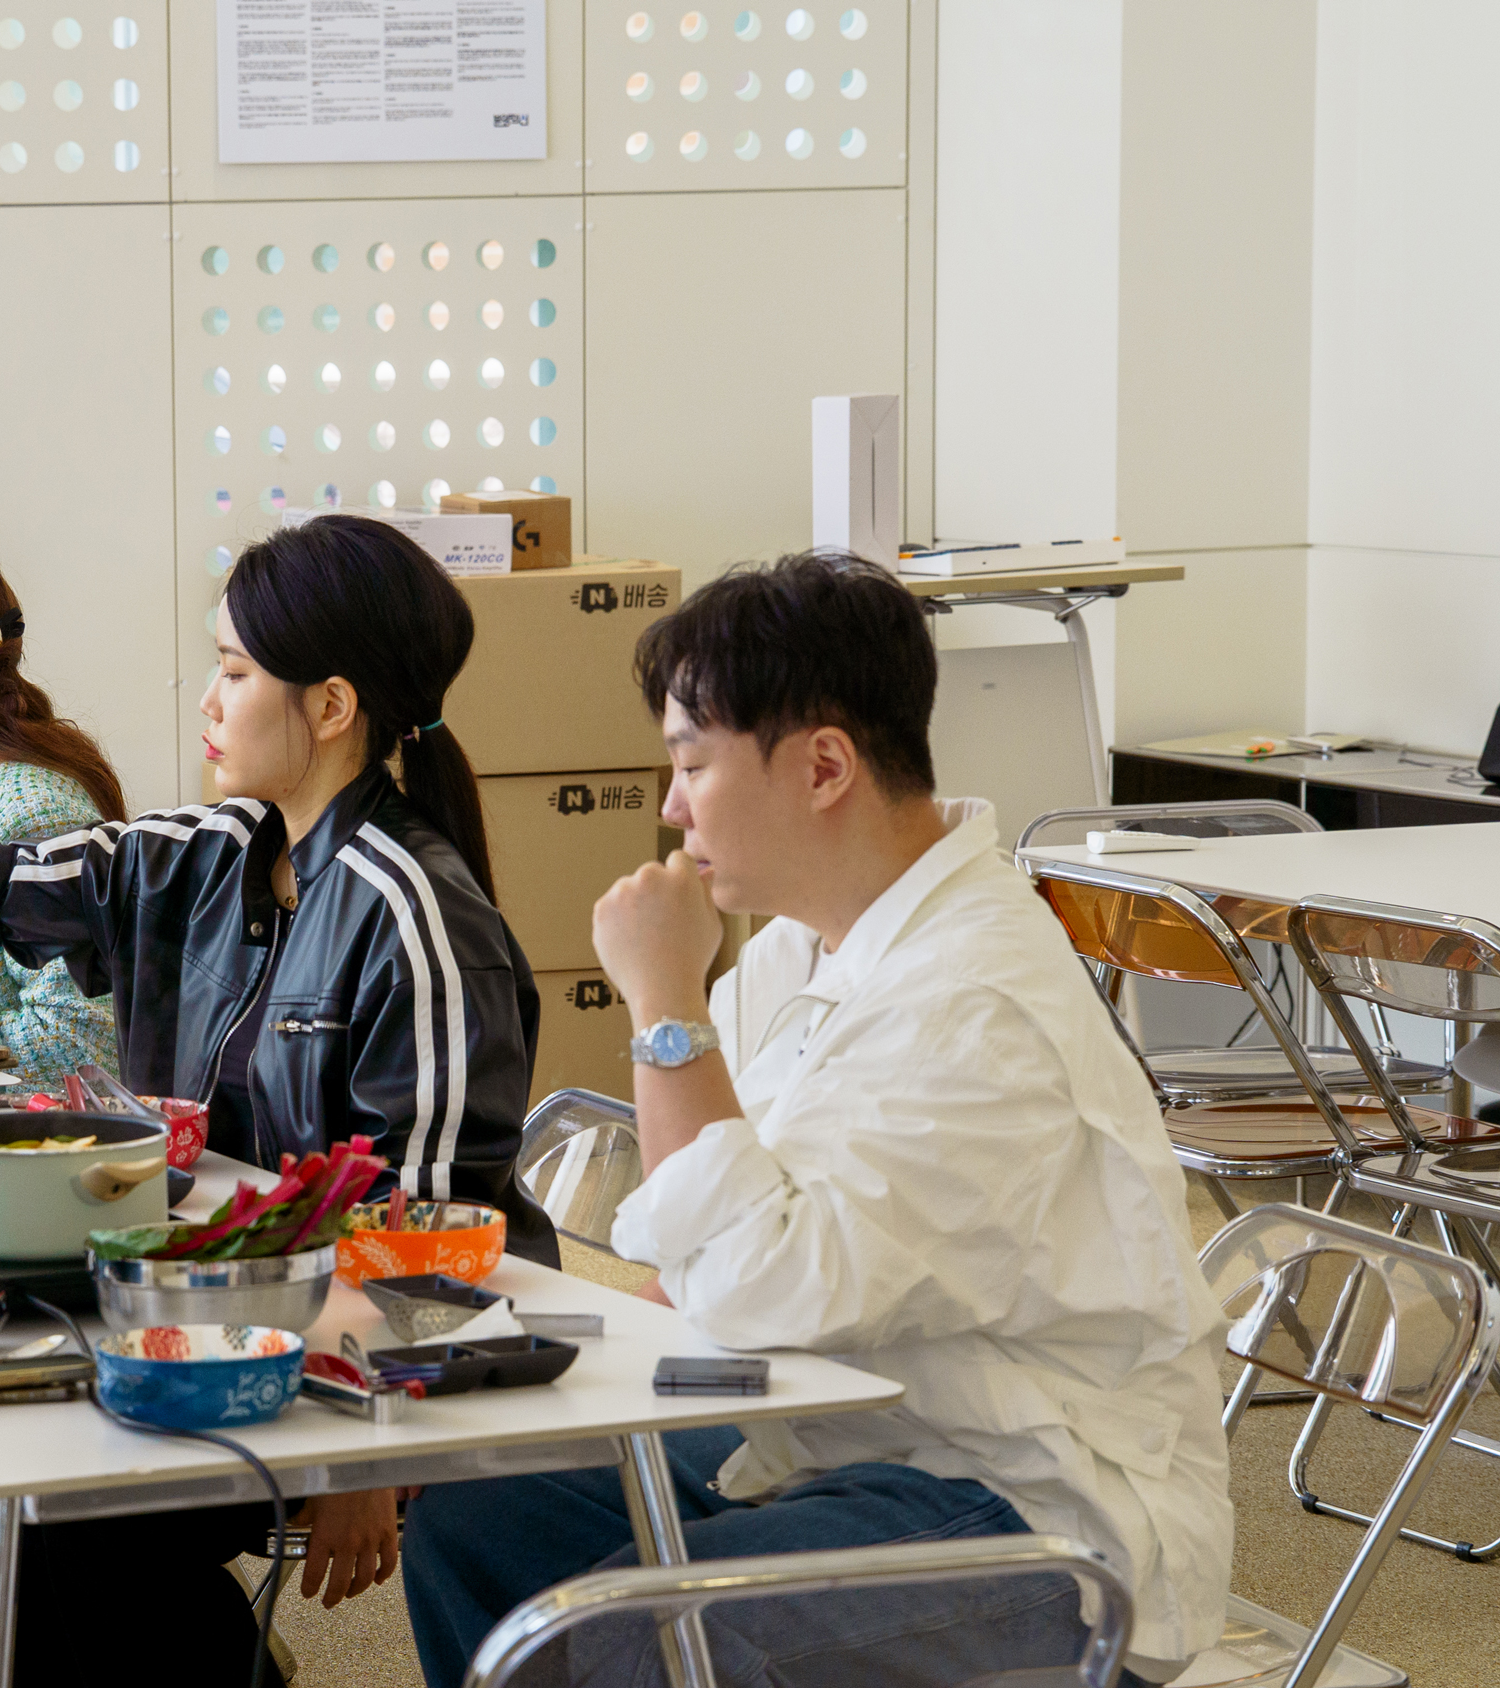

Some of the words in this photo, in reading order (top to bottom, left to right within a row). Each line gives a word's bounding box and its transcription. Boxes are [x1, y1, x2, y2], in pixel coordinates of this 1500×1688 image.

[444, 553, 505, 563] MK-120CG
[623, 584, 668, 608] 배송
[601, 786, 645, 809] 배송
